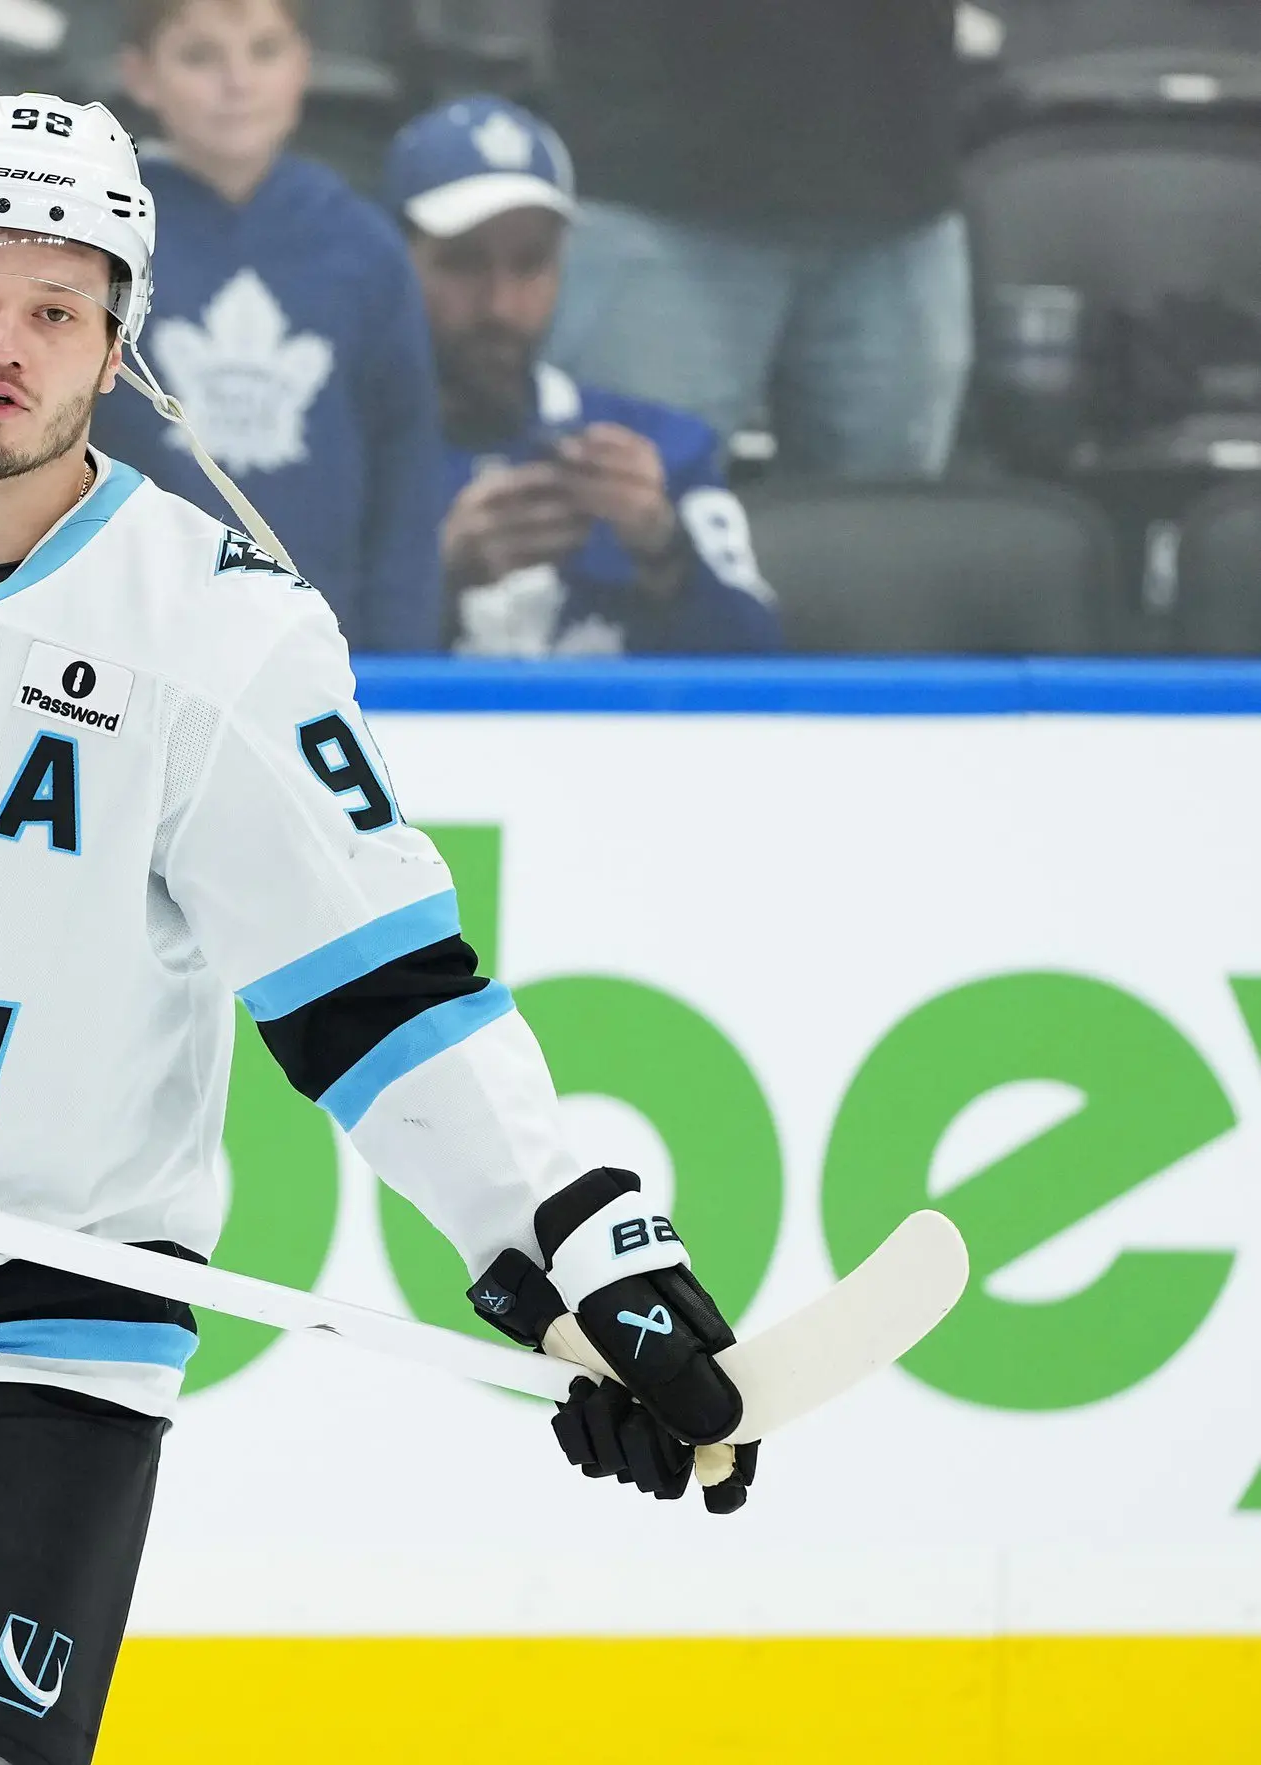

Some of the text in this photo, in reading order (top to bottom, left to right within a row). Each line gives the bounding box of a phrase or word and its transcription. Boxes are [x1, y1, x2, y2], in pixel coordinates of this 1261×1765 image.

[11, 108, 73, 137] 98
[20, 685, 120, 732] 1Password
[293, 708, 406, 835] 9
